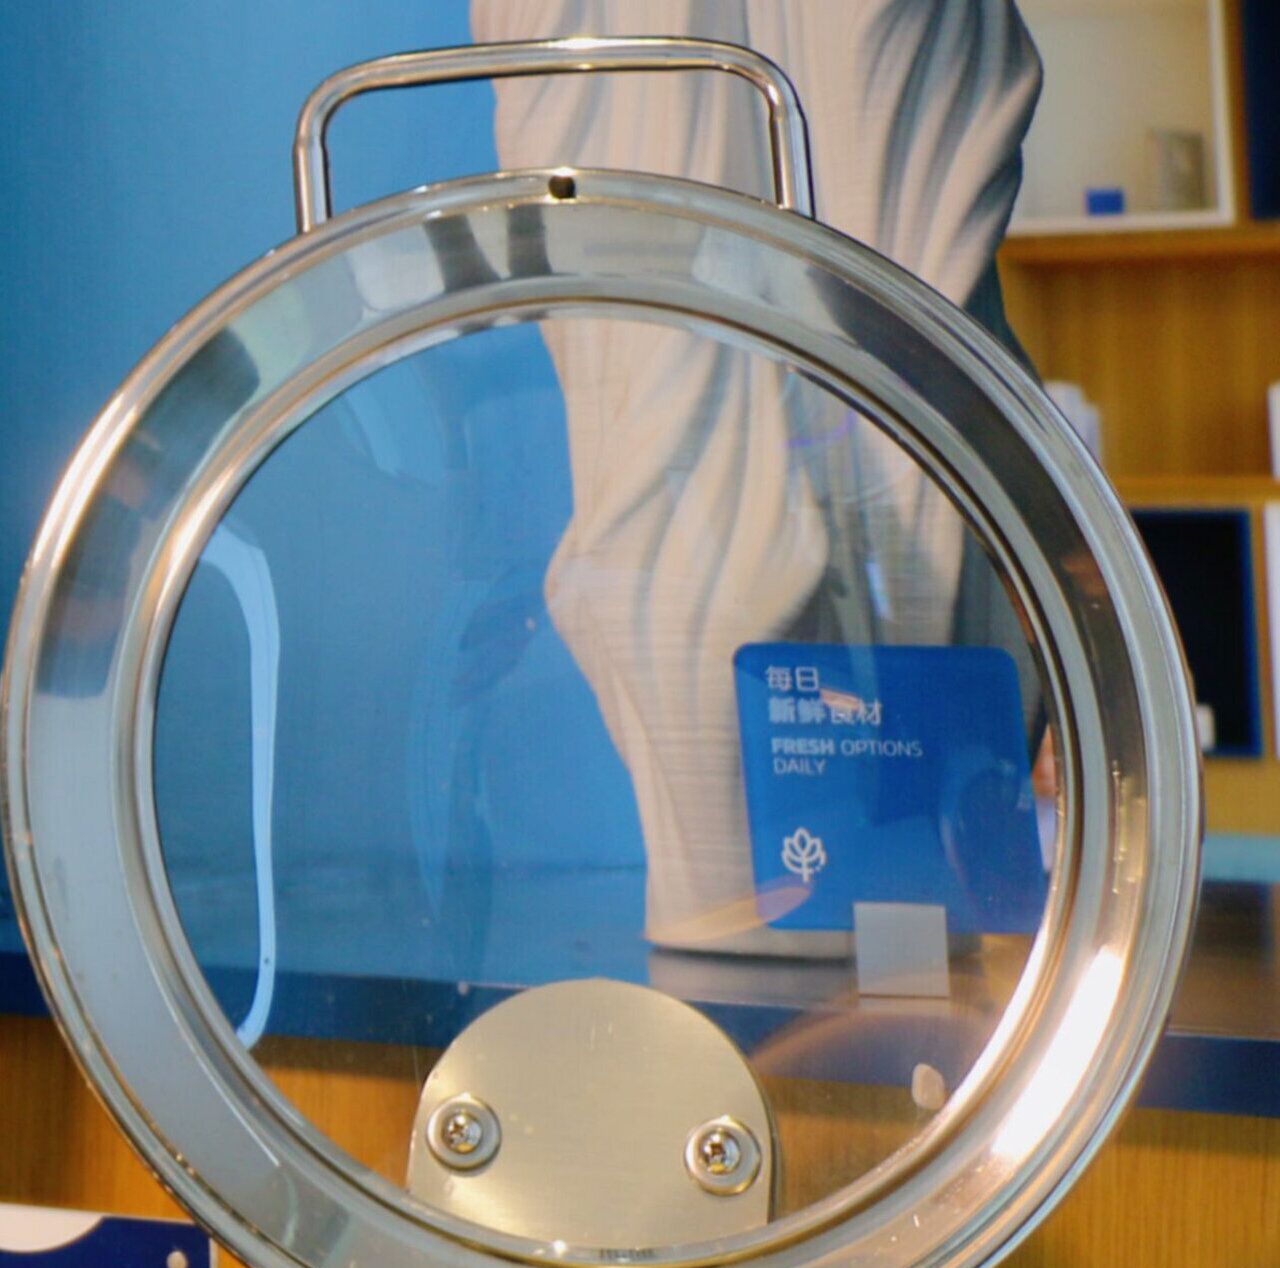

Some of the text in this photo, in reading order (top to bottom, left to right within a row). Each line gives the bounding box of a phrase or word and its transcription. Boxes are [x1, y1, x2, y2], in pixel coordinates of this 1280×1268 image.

[766, 666, 819, 690] 每日
[772, 738, 923, 757] FRESH OPTIONS
[773, 759, 826, 775] DAILY
